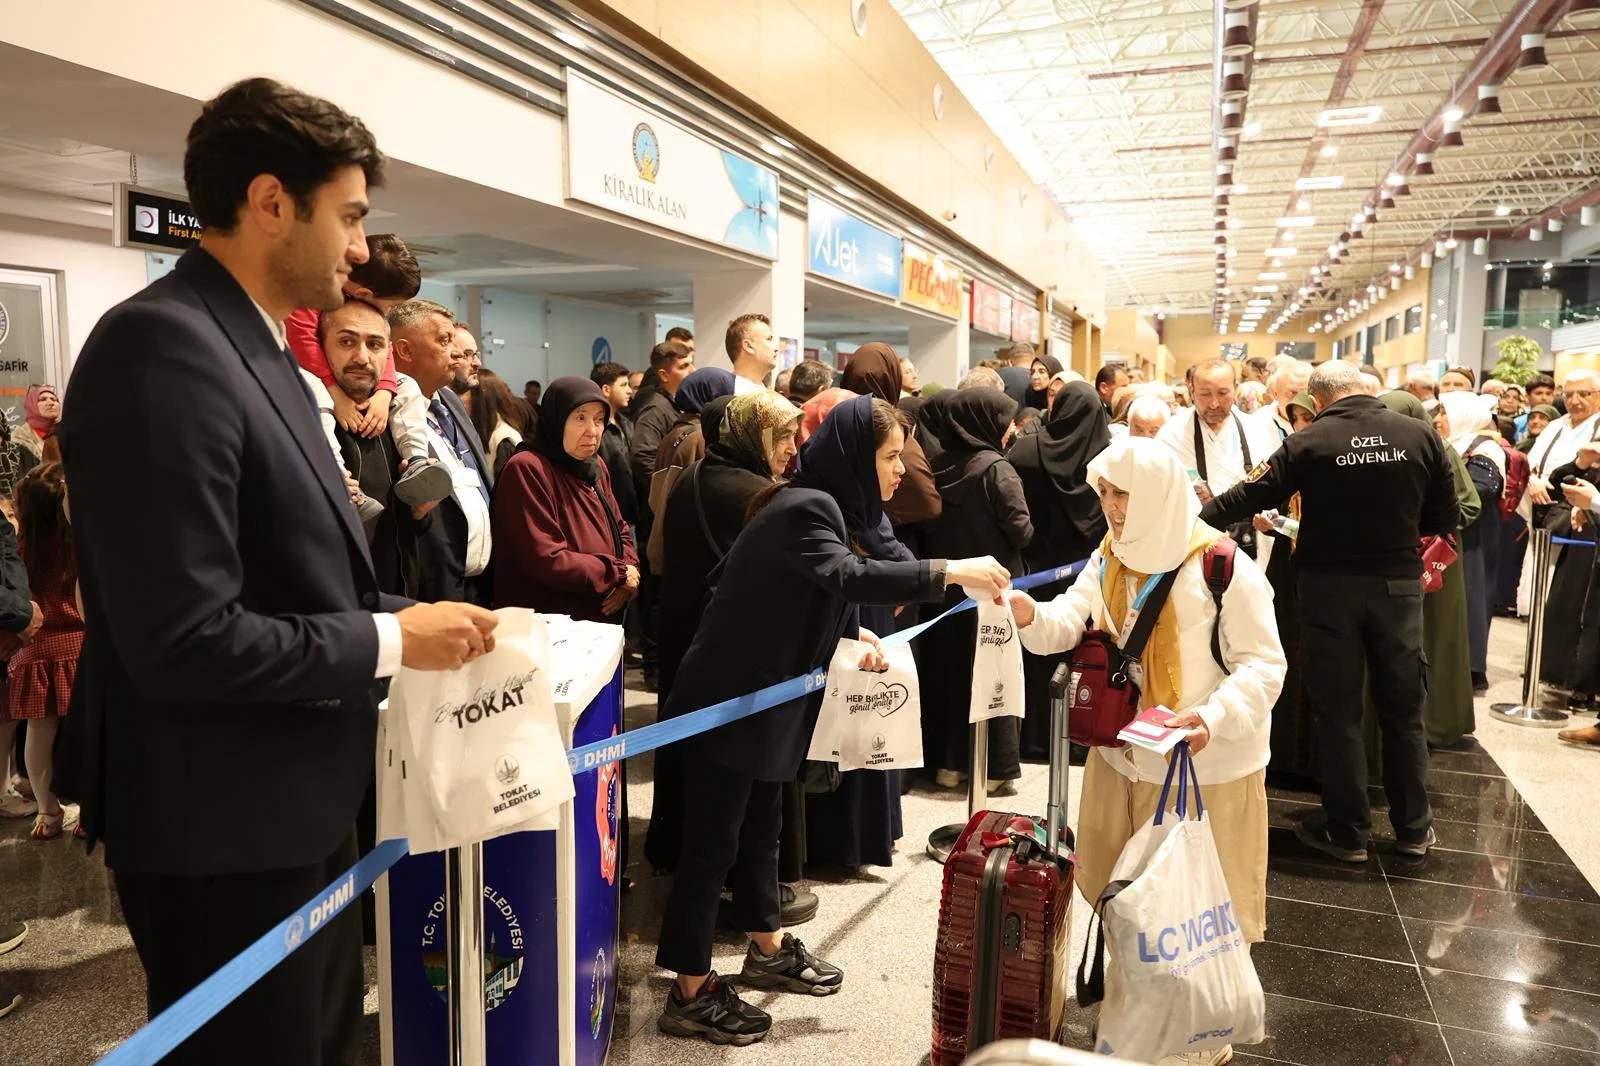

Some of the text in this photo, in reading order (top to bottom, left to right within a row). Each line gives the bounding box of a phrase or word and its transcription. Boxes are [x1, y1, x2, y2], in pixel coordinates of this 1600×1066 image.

[603, 173, 686, 220] KİRALIK ALAN
[168, 209, 202, 229] İLK YA
[168, 226, 189, 238] First
[1350, 435, 1389, 449] ÖZEL
[1335, 448, 1408, 466] GÜVENLİK
[815, 671, 828, 687] DH
[451, 684, 524, 729] TOKAT
[583, 738, 626, 768] DHMİ
[493, 788, 541, 814] BELEDİYESİ
[499, 784, 528, 801] TOKAT
[309, 872, 354, 931] DHMİ
[422, 923, 436, 947] T.C.
[484, 885, 523, 950] ELEDİYESİ
[1137, 926, 1180, 963] LC
[1180, 901, 1238, 953] Waik
